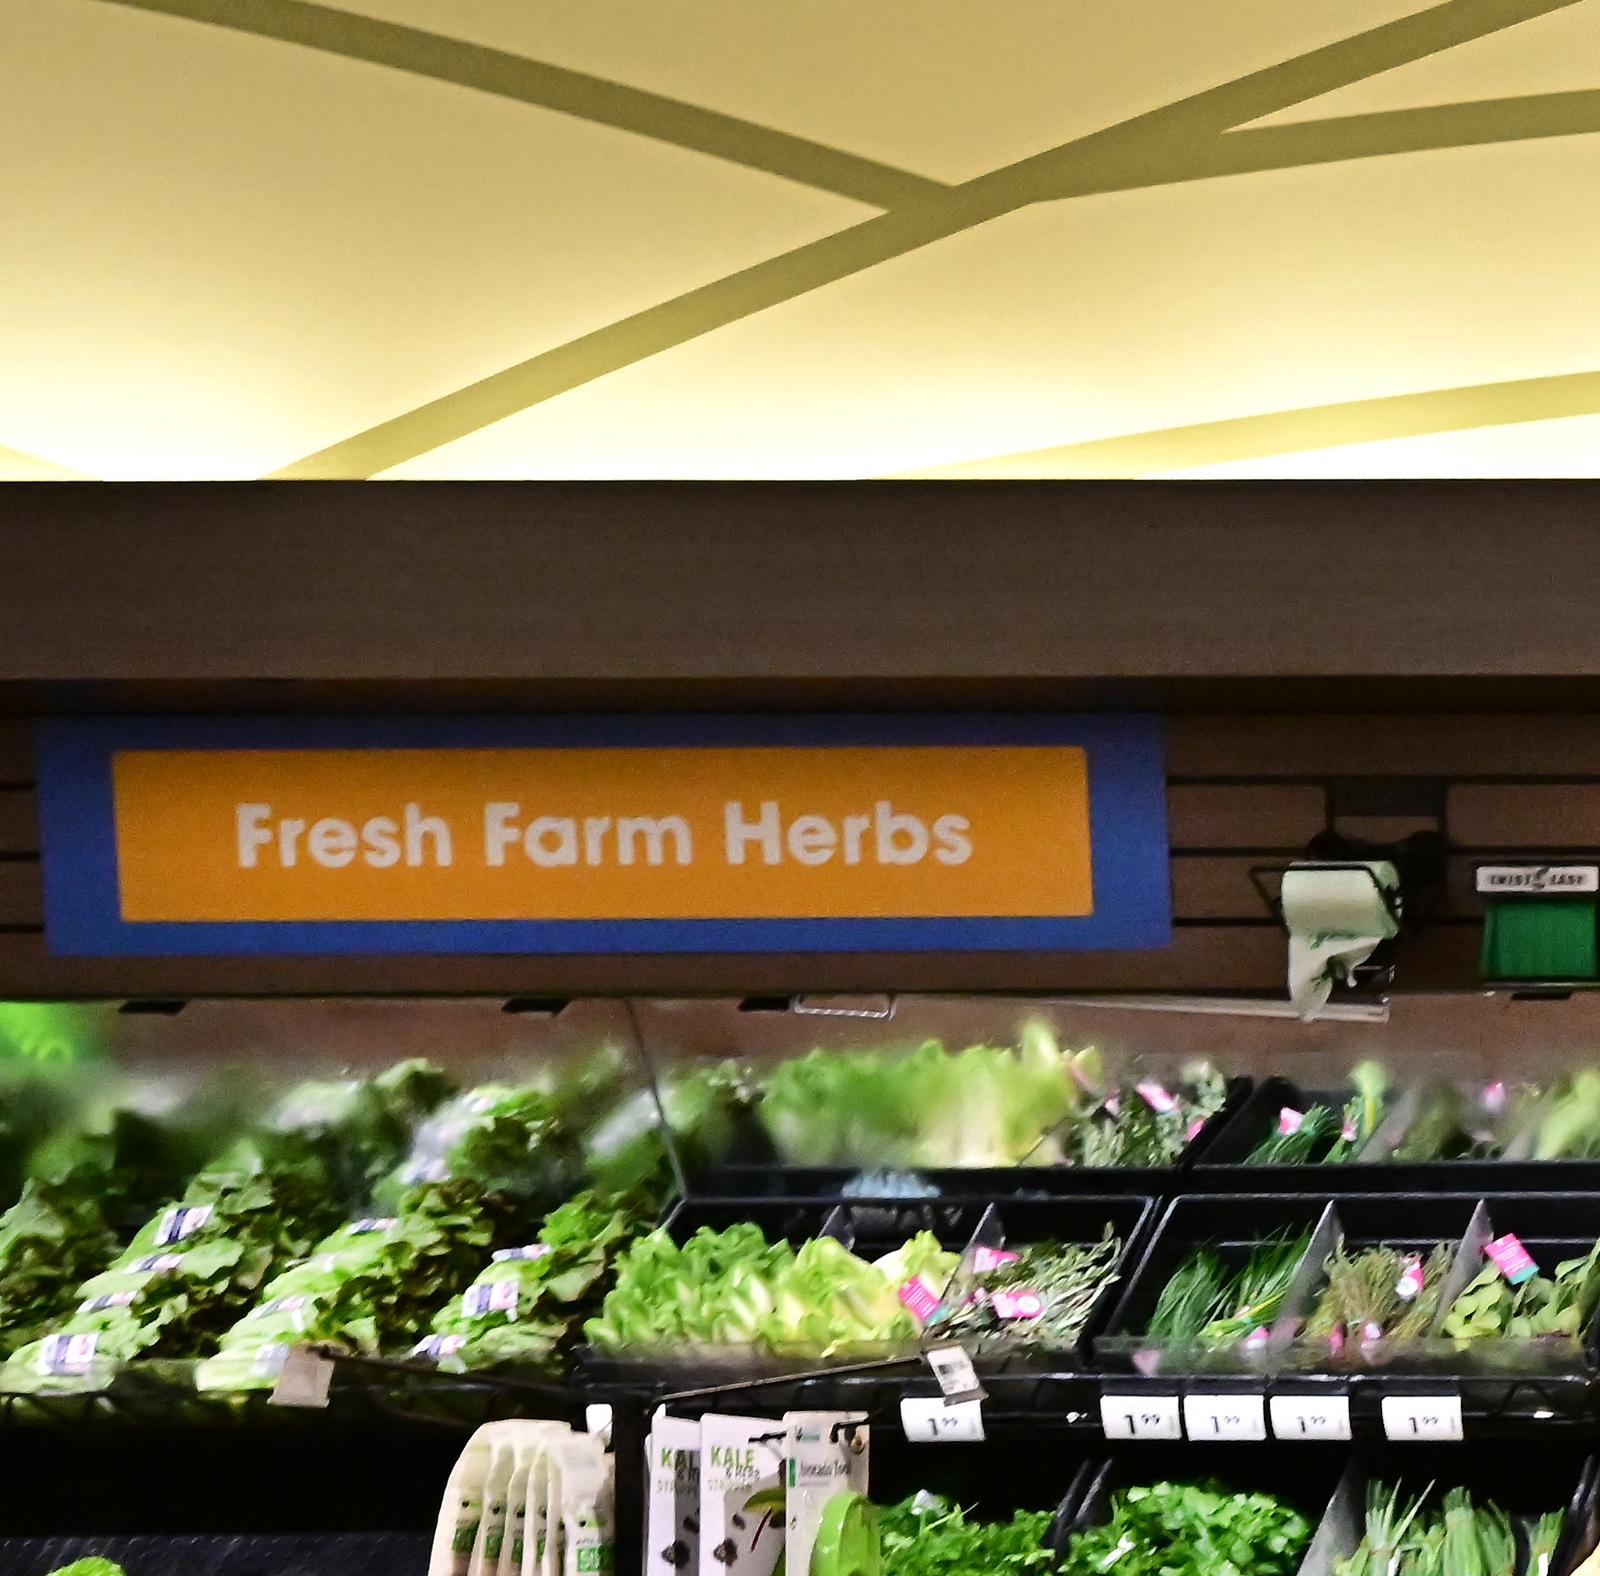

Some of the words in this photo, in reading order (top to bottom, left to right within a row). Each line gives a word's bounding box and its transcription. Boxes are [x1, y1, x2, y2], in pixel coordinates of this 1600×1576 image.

[237, 803, 452, 869] Fresh
[484, 802, 693, 868] Farm
[724, 801, 973, 866] Herbs
[710, 1446, 755, 1467] KALE
